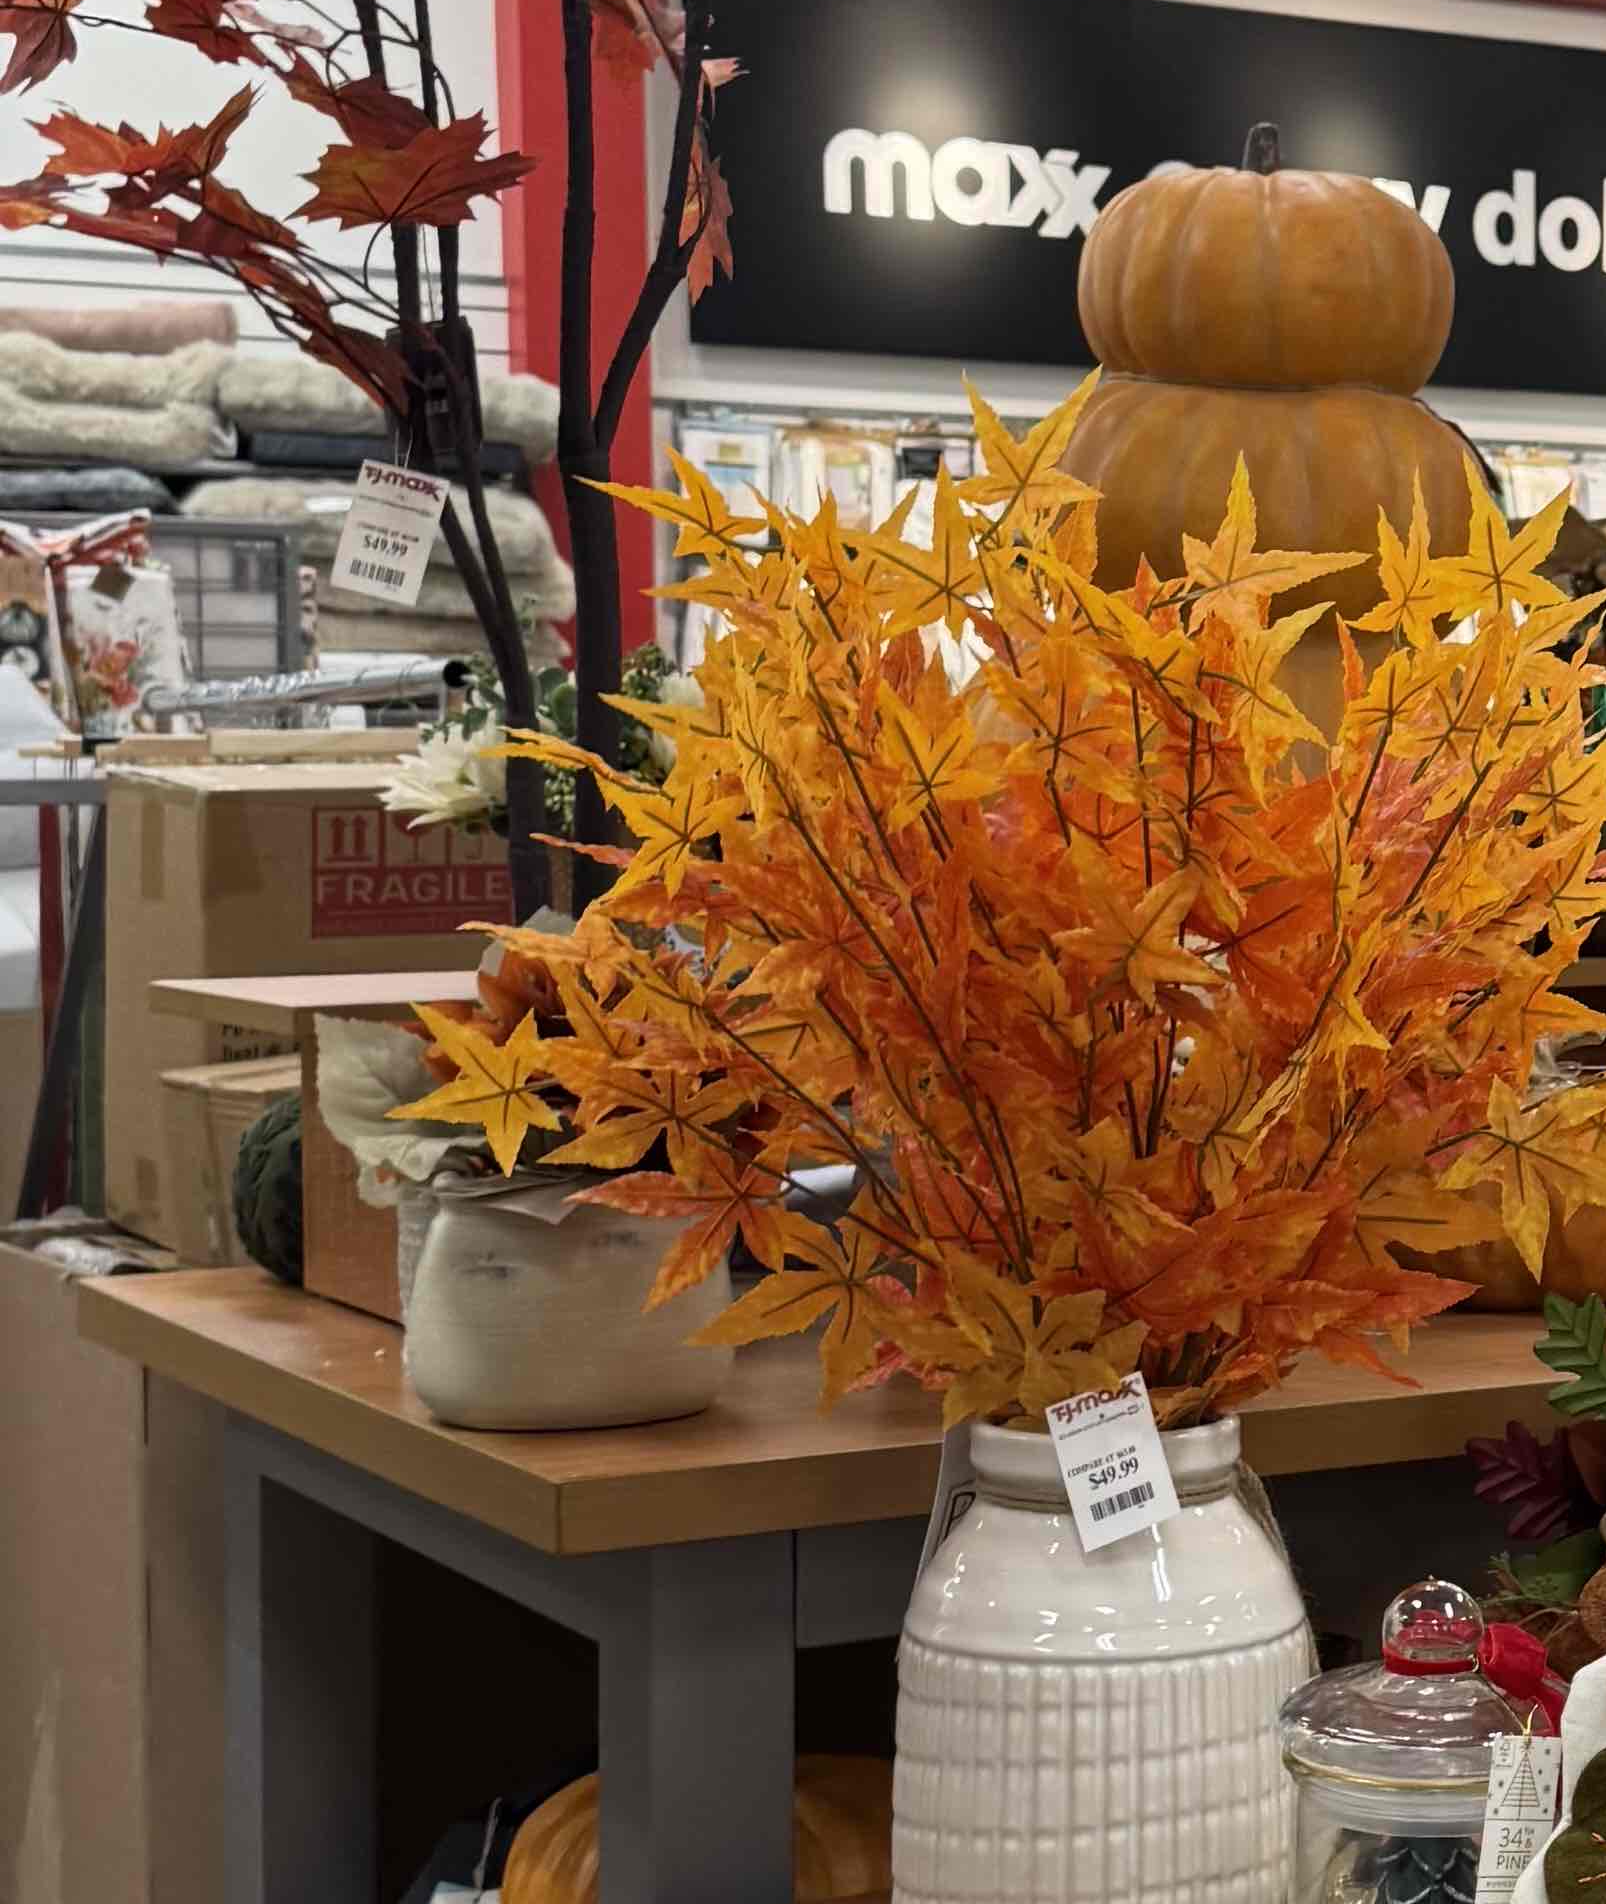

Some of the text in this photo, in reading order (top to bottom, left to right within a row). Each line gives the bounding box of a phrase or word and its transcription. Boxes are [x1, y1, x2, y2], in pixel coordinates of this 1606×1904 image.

[823, 128, 1112, 238] maxx
[317, 872, 508, 904] FRAGILE
[1088, 1457, 1138, 1490] $49.99
